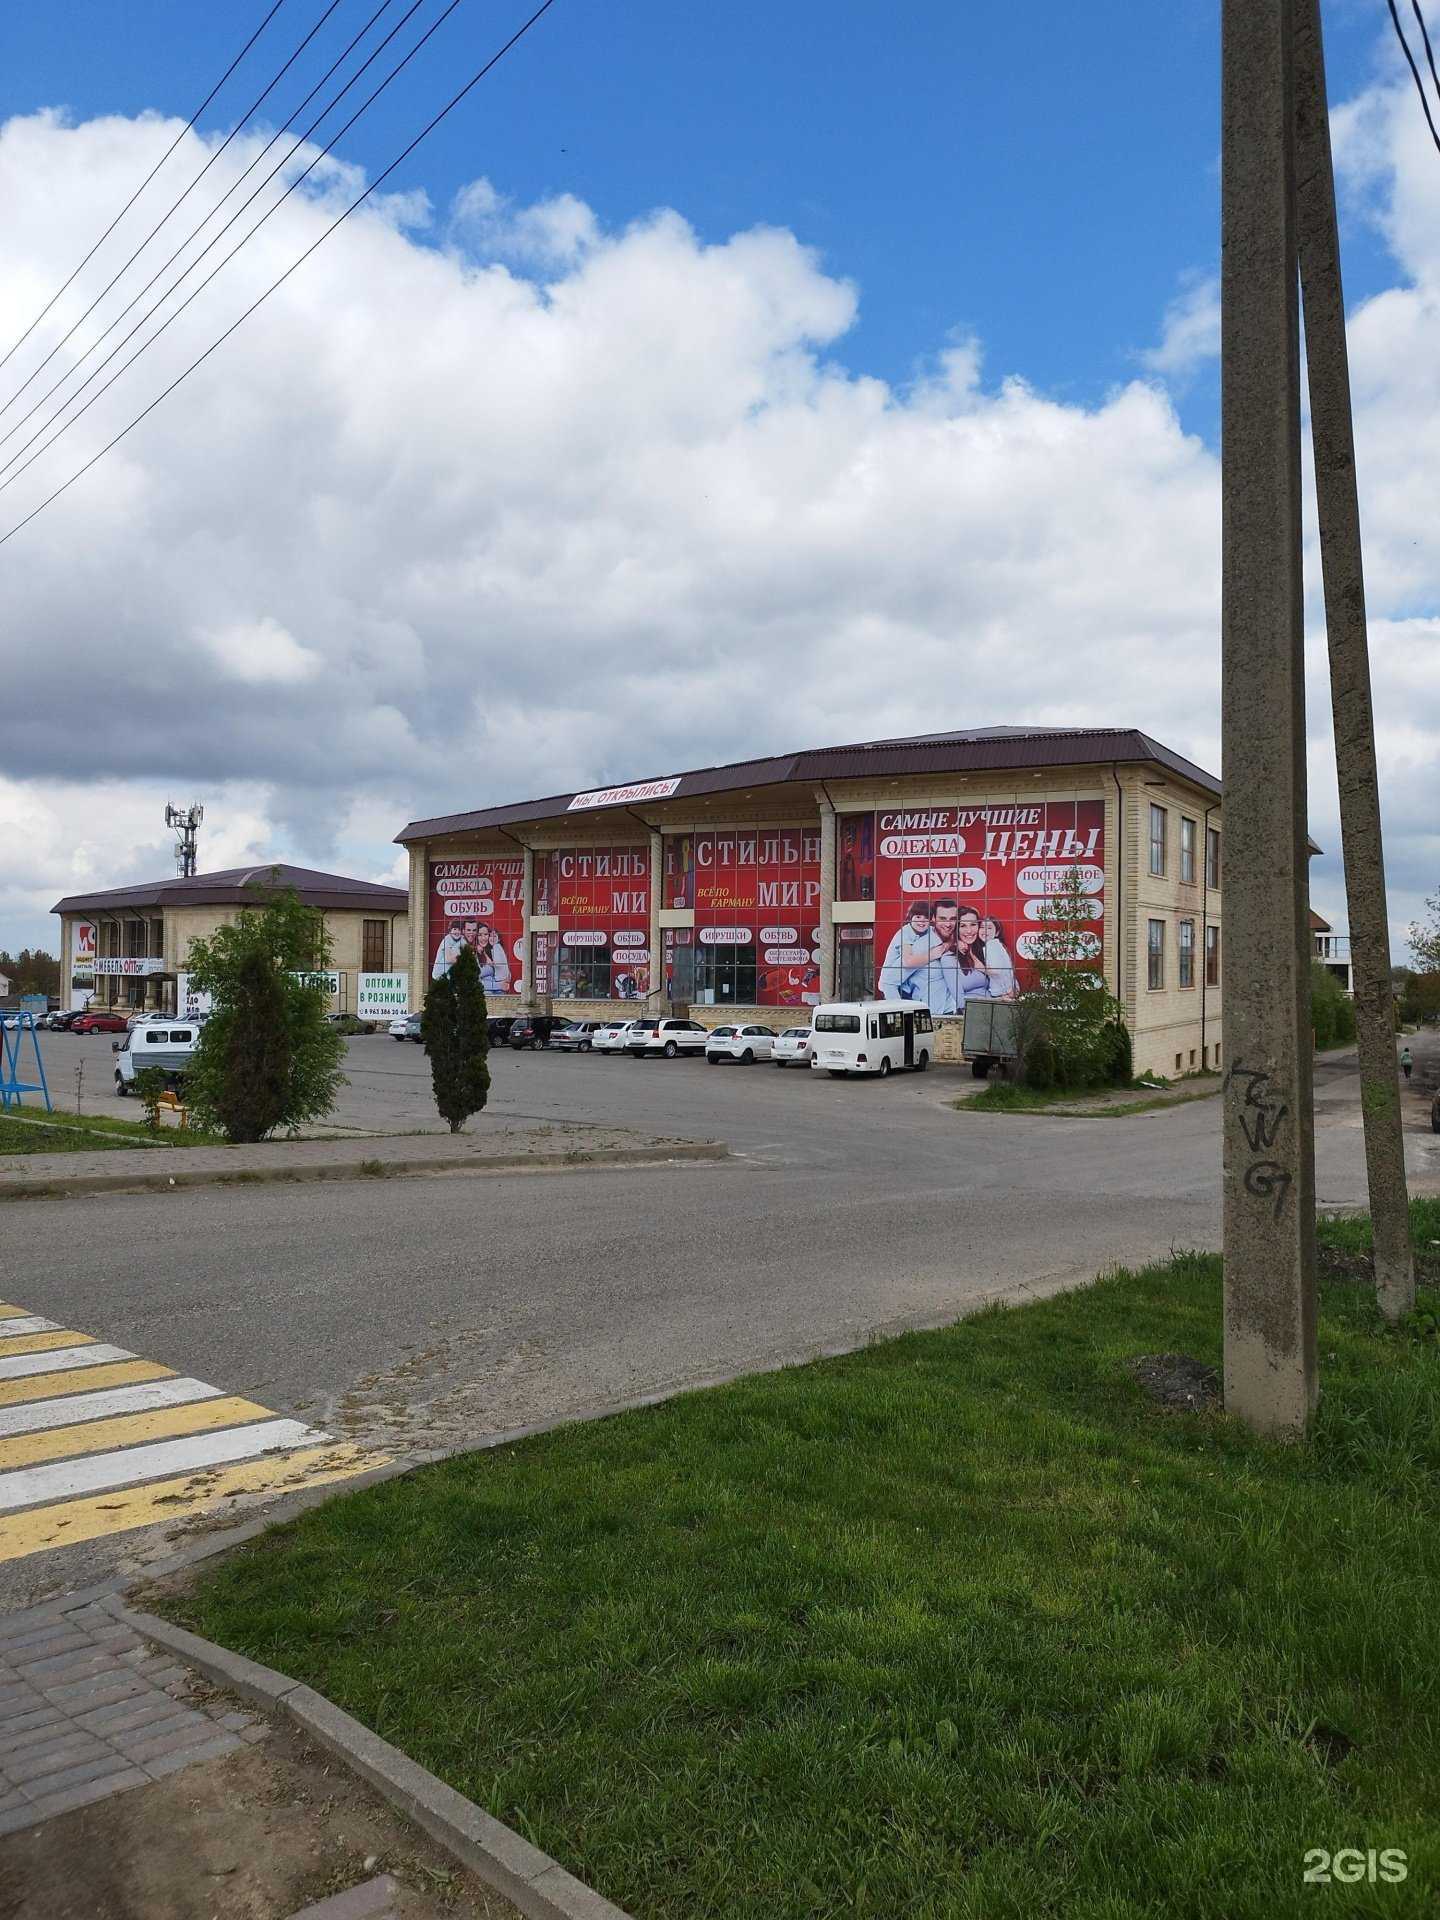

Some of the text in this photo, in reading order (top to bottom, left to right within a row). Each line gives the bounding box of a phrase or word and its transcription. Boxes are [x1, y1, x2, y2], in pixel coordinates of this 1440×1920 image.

[572, 782, 676, 808] МЫ ОТКРЫЛИСЬ!
[880, 808, 1041, 830] САМЫЕ ЛУЧШИЕ
[886, 838, 959, 856] ОДЕЖДА
[981, 828, 1101, 866] ЦЕНЫ
[434, 864, 479, 877] САМЫЕ
[1023, 869, 1101, 881] ПОСТЕЛНОЕ
[910, 872, 974, 889] ОБУВЬ
[440, 880, 489, 894] ОДЕЖДА
[697, 886, 730, 898] ВСЁ ПО
[561, 895, 588, 905] ВСЁ ПО
[758, 881, 821, 907] МИР
[450, 901, 488, 914] ОБУВЬ
[711, 898, 755, 908] КАРМАНУ
[572, 905, 610, 915] КАРМАНУ
[567, 935, 603, 944] ИГРУШКИ
[617, 934, 641, 943] ОБУВЬ
[704, 931, 746, 940] ИГРУШКИ
[764, 930, 793, 940] ОБУВЬ
[616, 952, 648, 962] ПОСУДА
[98, 960, 122, 974] МЕБЕЛЬ
[365, 978, 401, 989] ОПТОМ И
[360, 992, 407, 1004] В РОЗНИЦУ
